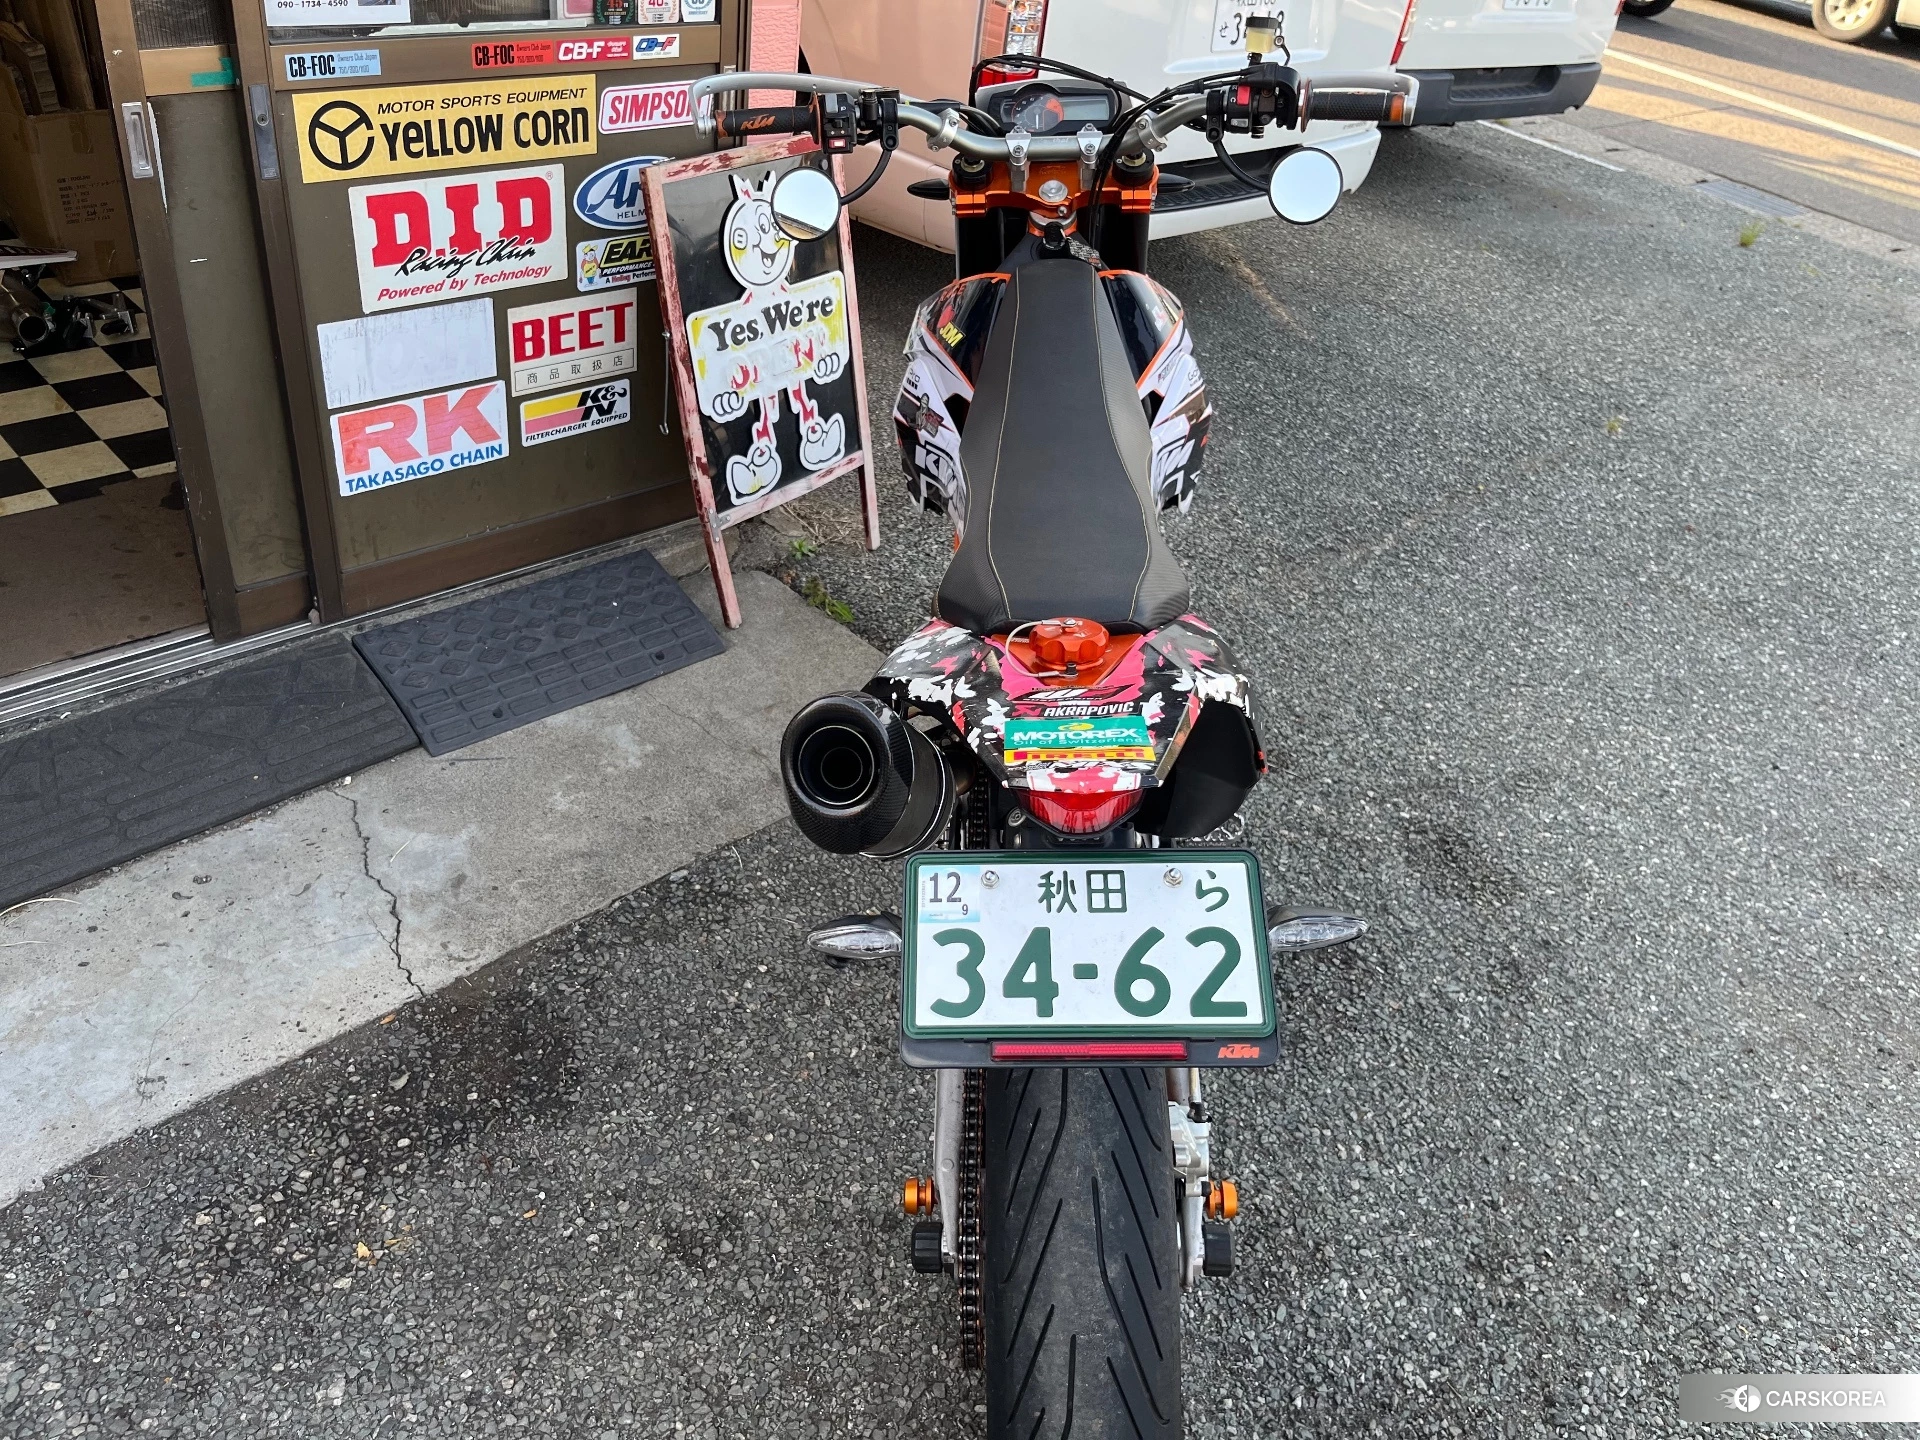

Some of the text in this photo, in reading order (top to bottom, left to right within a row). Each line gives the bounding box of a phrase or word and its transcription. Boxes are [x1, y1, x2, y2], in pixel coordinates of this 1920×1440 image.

[474, 44, 515, 67] CB-FOC
[558, 40, 605, 61] CB-F
[635, 36, 677, 53] CB-F
[288, 54, 336, 78] CB-FOC
[377, 88, 587, 115] MOTOR SPORTS EQUIPMENT
[740, 113, 776, 131] KTM
[587, 168, 644, 214] Ar
[366, 176, 553, 268] D.I.D
[617, 209, 647, 220] HELM
[394, 236, 537, 279] Racing Chain
[603, 238, 653, 265] EAR
[602, 261, 653, 275] PERFORMANCE
[377, 264, 553, 302] Powered by Technology
[512, 301, 634, 364] BEET
[527, 355, 623, 385] 商品取扱店
[337, 383, 502, 476] RK
[525, 412, 628, 443] FILTERCHARGER EQUIPPED
[345, 443, 503, 493] TAKASAGO CHAIN
[1043, 701, 1135, 717] AKRAPOVIC
[1012, 728, 1143, 742] MOTOREX
[1058, 736, 1144, 747] Switzerland
[1013, 748, 1145, 761] PIRELLI
[929, 871, 962, 903] 12
[1037, 869, 1230, 913] 秋田 ら
[961, 903, 969, 916] 9
[929, 925, 1248, 1019] 34-62
[1217, 1044, 1261, 1059] KTM
